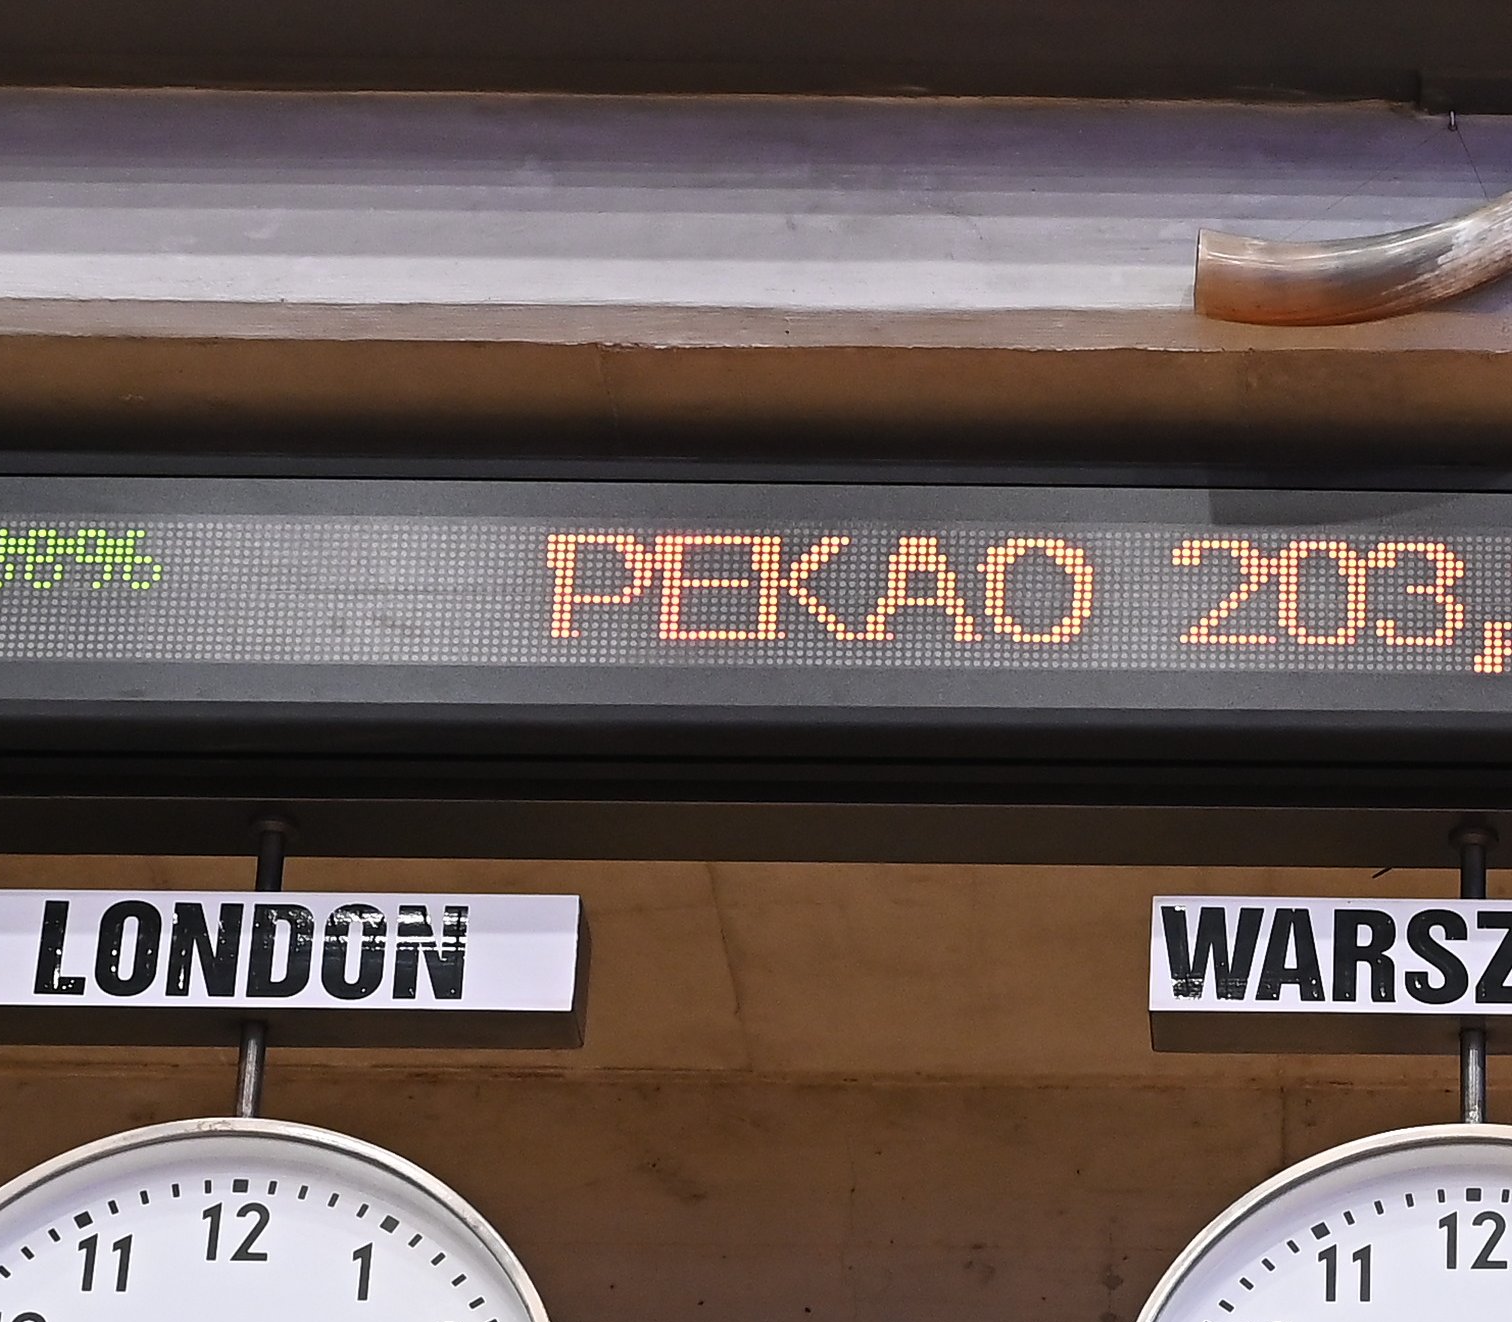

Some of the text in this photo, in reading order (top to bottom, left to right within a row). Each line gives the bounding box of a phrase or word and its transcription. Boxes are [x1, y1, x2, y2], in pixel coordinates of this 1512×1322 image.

[549, 534, 1093, 642] PEKAO
[34, 900, 468, 1000] LONDON
[202, 1202, 270, 1262] 12
[1438, 1210, 1508, 1270] 12
[78, 1233, 133, 1292] 11
[352, 1242, 373, 1301] 1
[1317, 1243, 1372, 1302] 11
